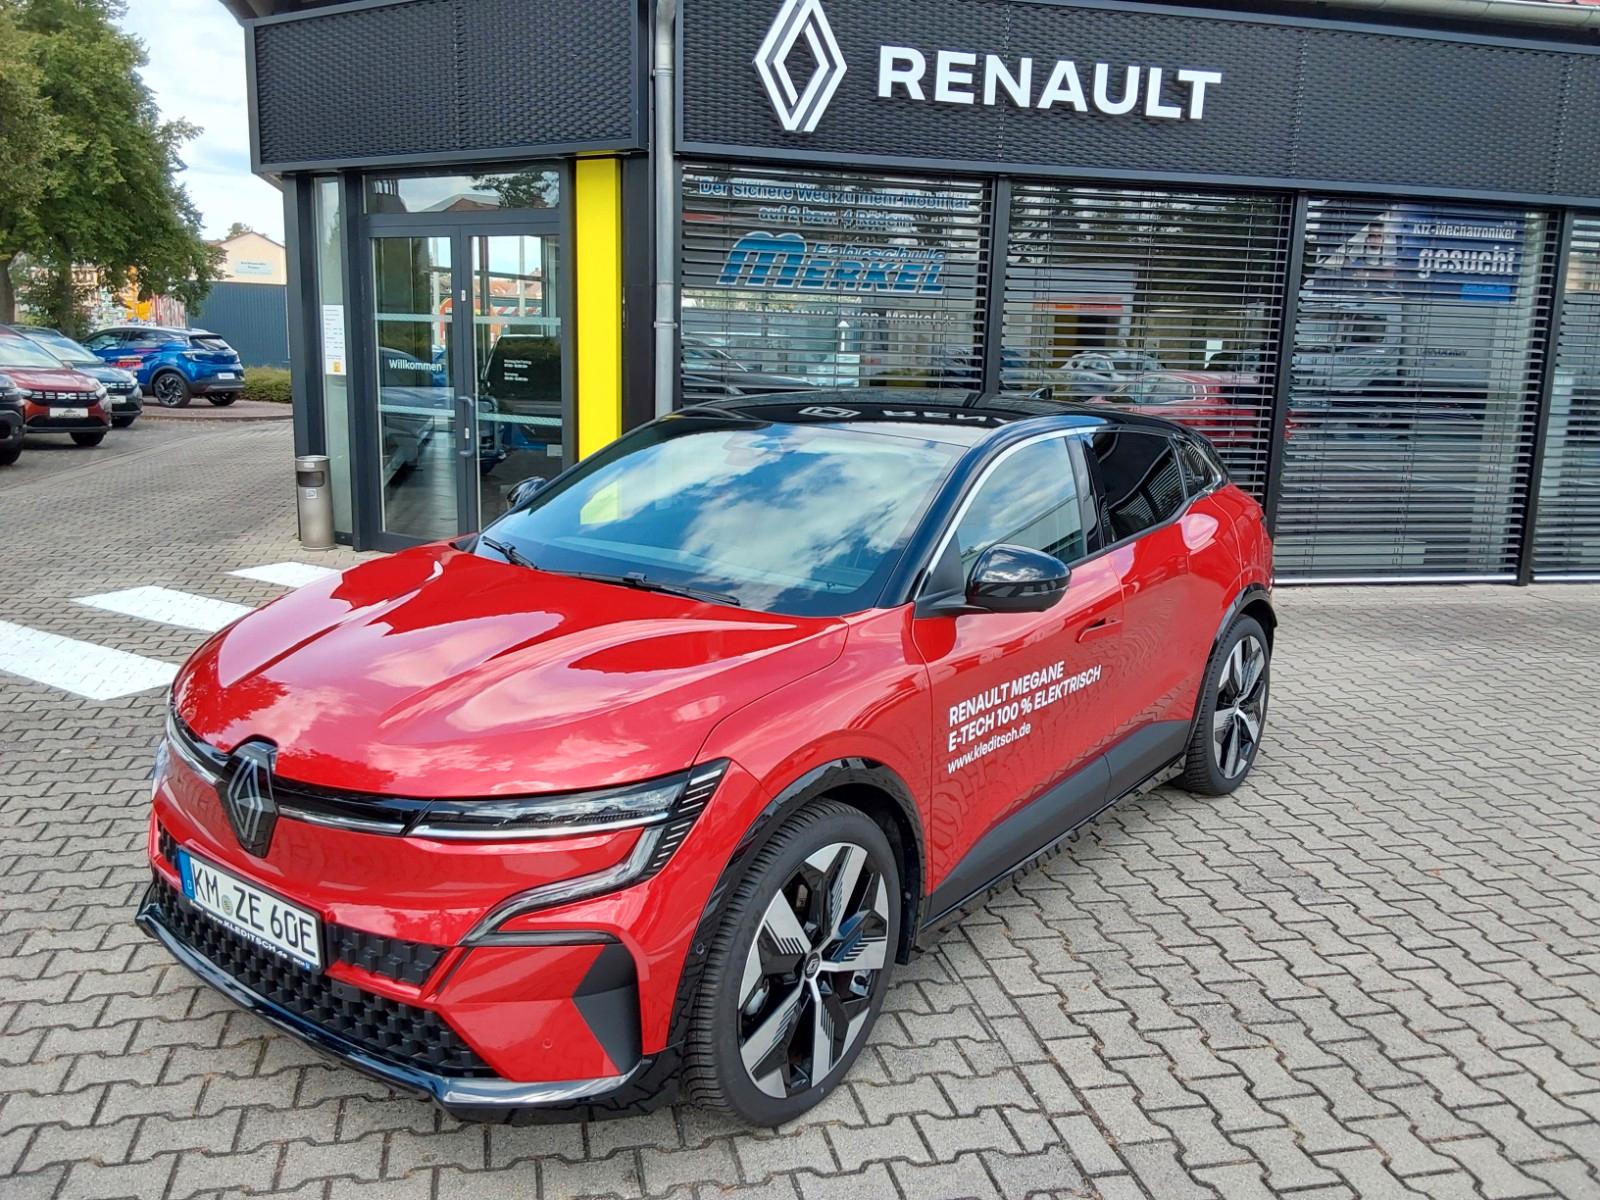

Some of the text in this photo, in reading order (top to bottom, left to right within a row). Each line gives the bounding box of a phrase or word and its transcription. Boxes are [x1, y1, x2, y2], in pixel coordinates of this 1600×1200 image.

[877, 45, 1222, 120] RENAULT
[699, 179, 730, 196] Der
[732, 182, 795, 200] sichere
[715, 231, 944, 294] MERKEL
[1418, 245, 1517, 279] gesucht
[388, 359, 443, 371] Willkommen
[948, 664, 1101, 752] E-TECH 100 % ELEKTRISCH
[950, 661, 1064, 727] RENAULT MEGANE
[947, 722, 1032, 775] www.kleditsch.de
[192, 863, 316, 958] KM ZE 60E
